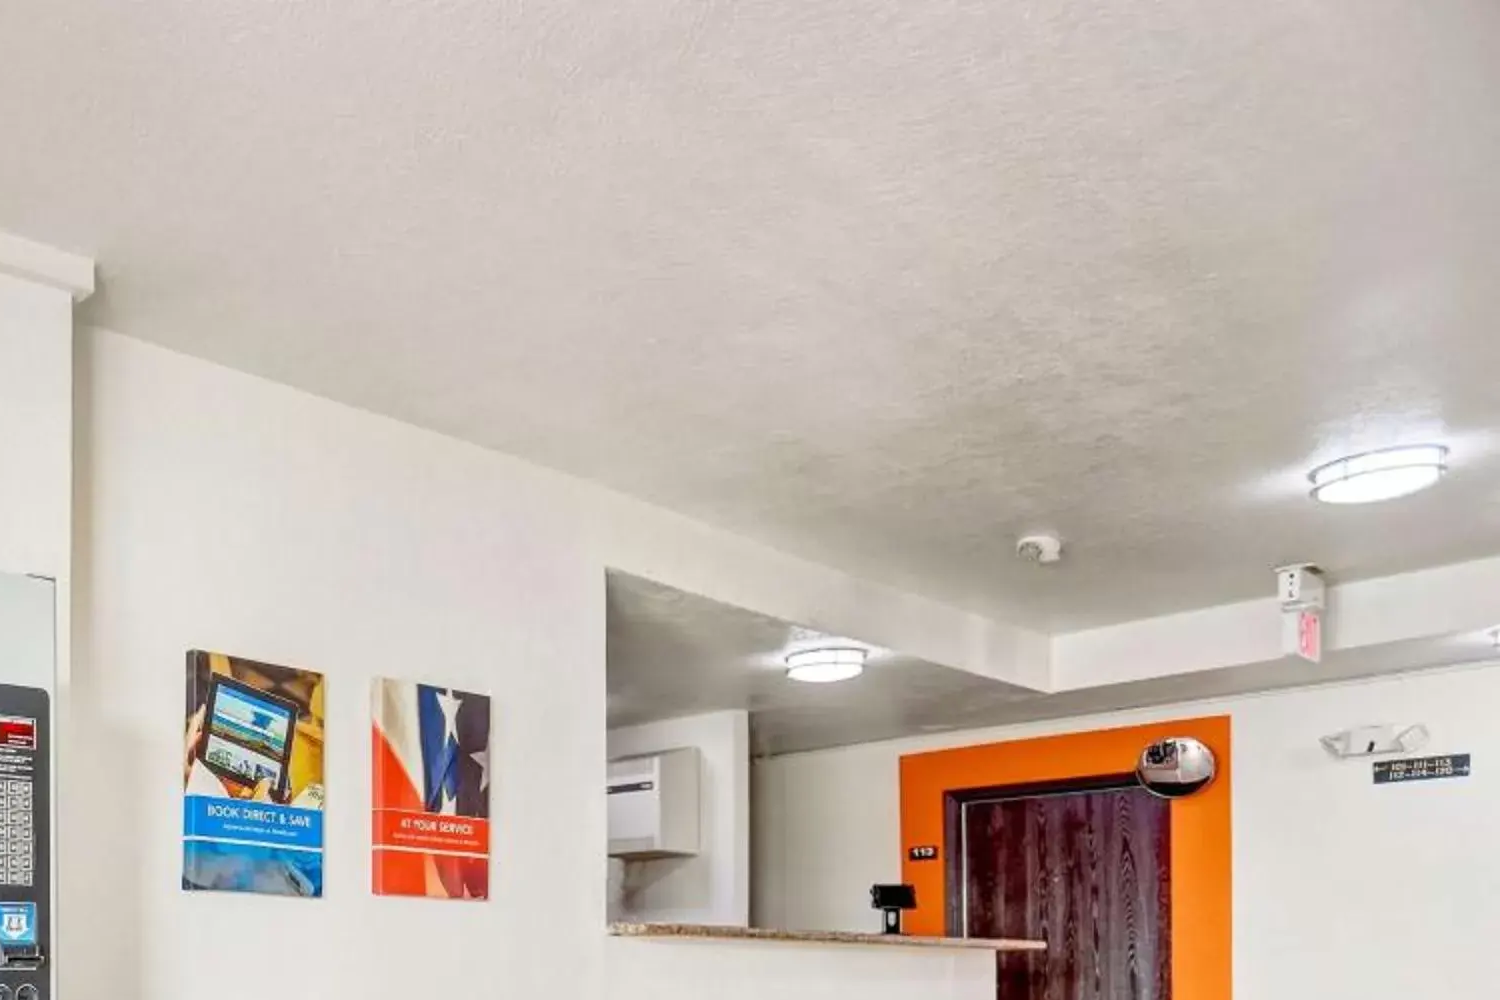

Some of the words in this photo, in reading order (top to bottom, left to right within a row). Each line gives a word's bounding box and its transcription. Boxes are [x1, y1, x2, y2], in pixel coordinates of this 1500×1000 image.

[207, 804, 241, 818] BOOK
[243, 808, 276, 824] DIRECT
[279, 813, 286, 825] &
[289, 816, 311, 829] SAVE
[400, 818, 411, 829] AT
[413, 819, 437, 832] YOUR
[439, 821, 474, 836] SERVICE
